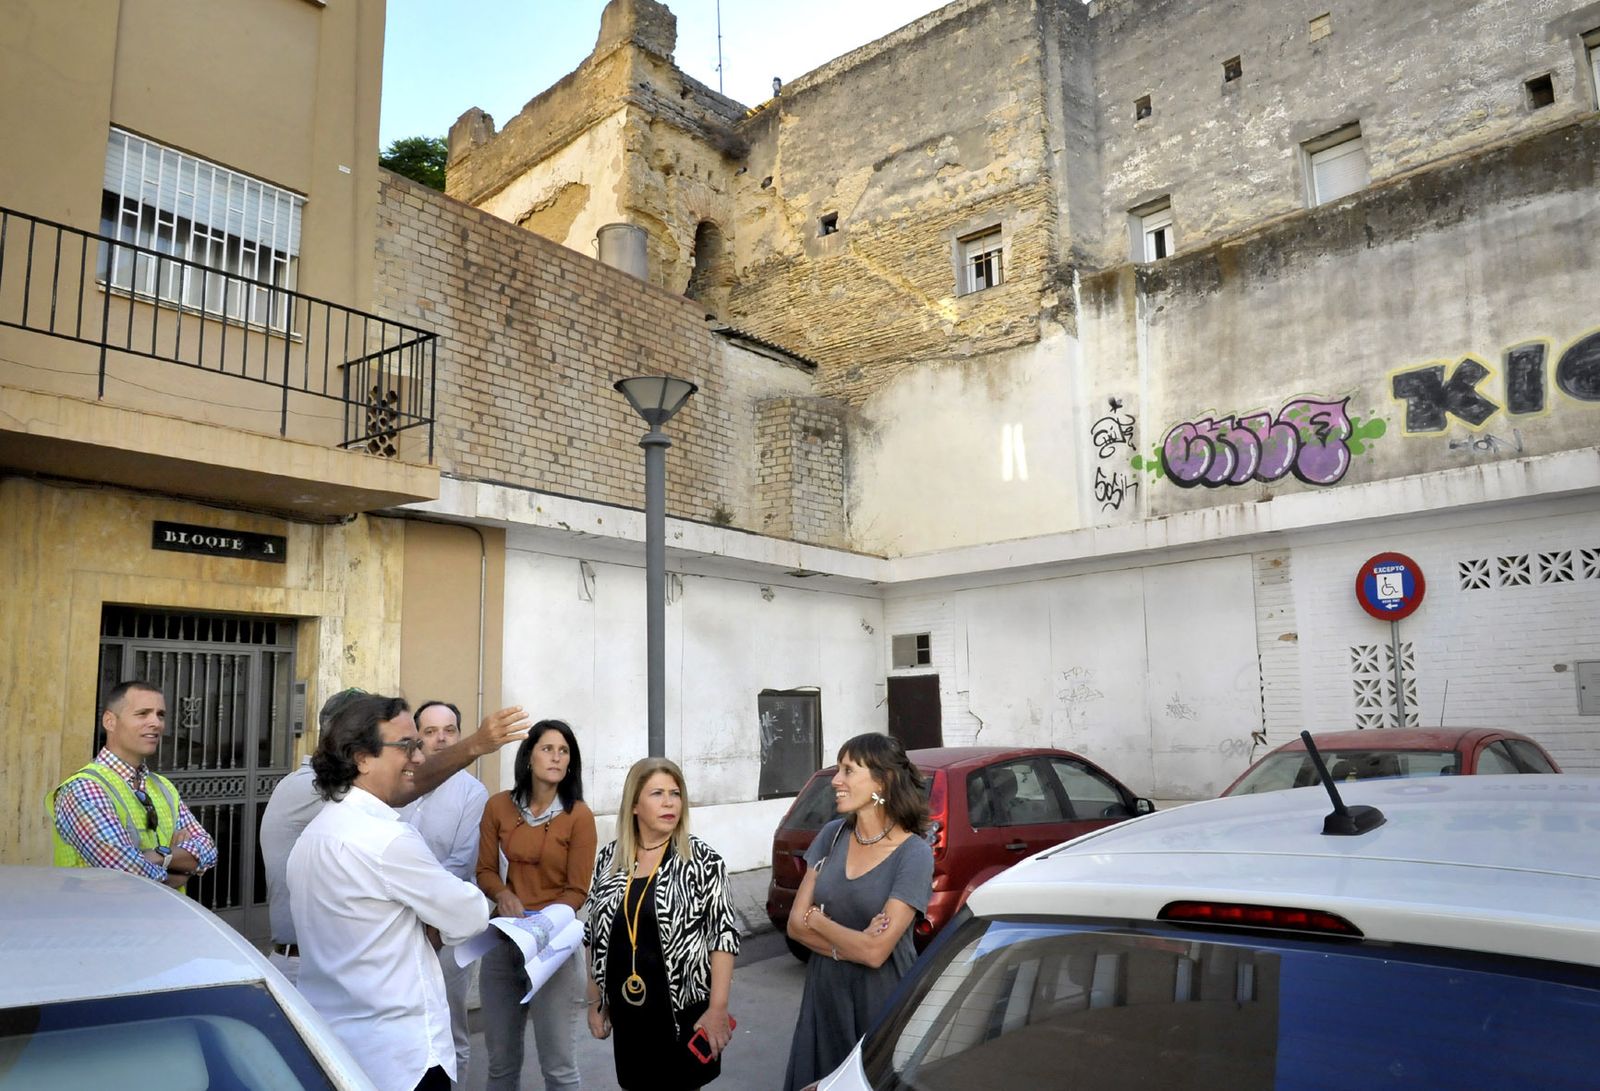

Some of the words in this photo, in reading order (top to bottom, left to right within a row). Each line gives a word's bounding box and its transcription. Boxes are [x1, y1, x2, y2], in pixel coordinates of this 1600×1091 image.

[164, 531, 243, 550] BLOQUE
[263, 542, 275, 553] A
[1374, 565, 1405, 574] EXCEPTO
